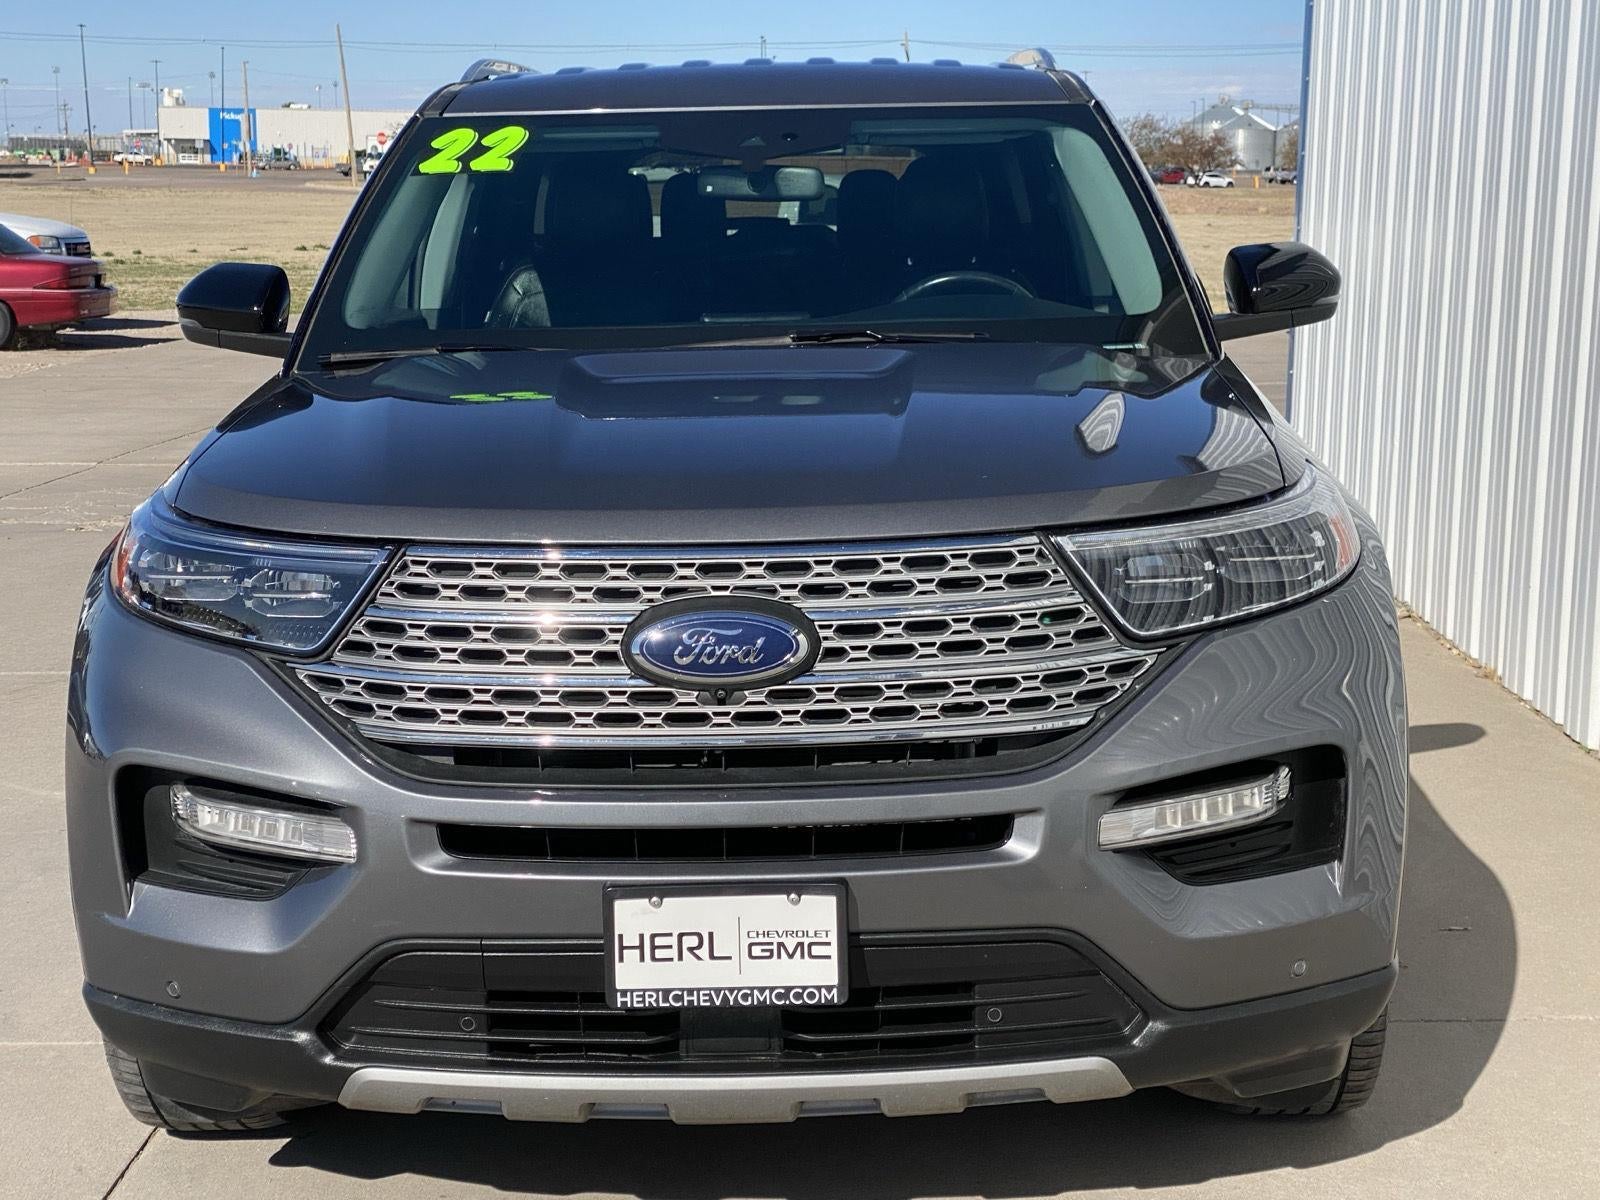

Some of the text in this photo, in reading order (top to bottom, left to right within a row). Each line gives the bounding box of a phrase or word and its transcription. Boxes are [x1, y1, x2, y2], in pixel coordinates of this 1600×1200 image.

[418, 125, 529, 174] 22
[673, 626, 766, 666] Ford
[617, 931, 733, 963] HERL
[747, 929, 832, 939] CHEVROLET
[747, 941, 832, 960] GMC
[616, 987, 838, 1008] HERLCHEVYGMC.COM
